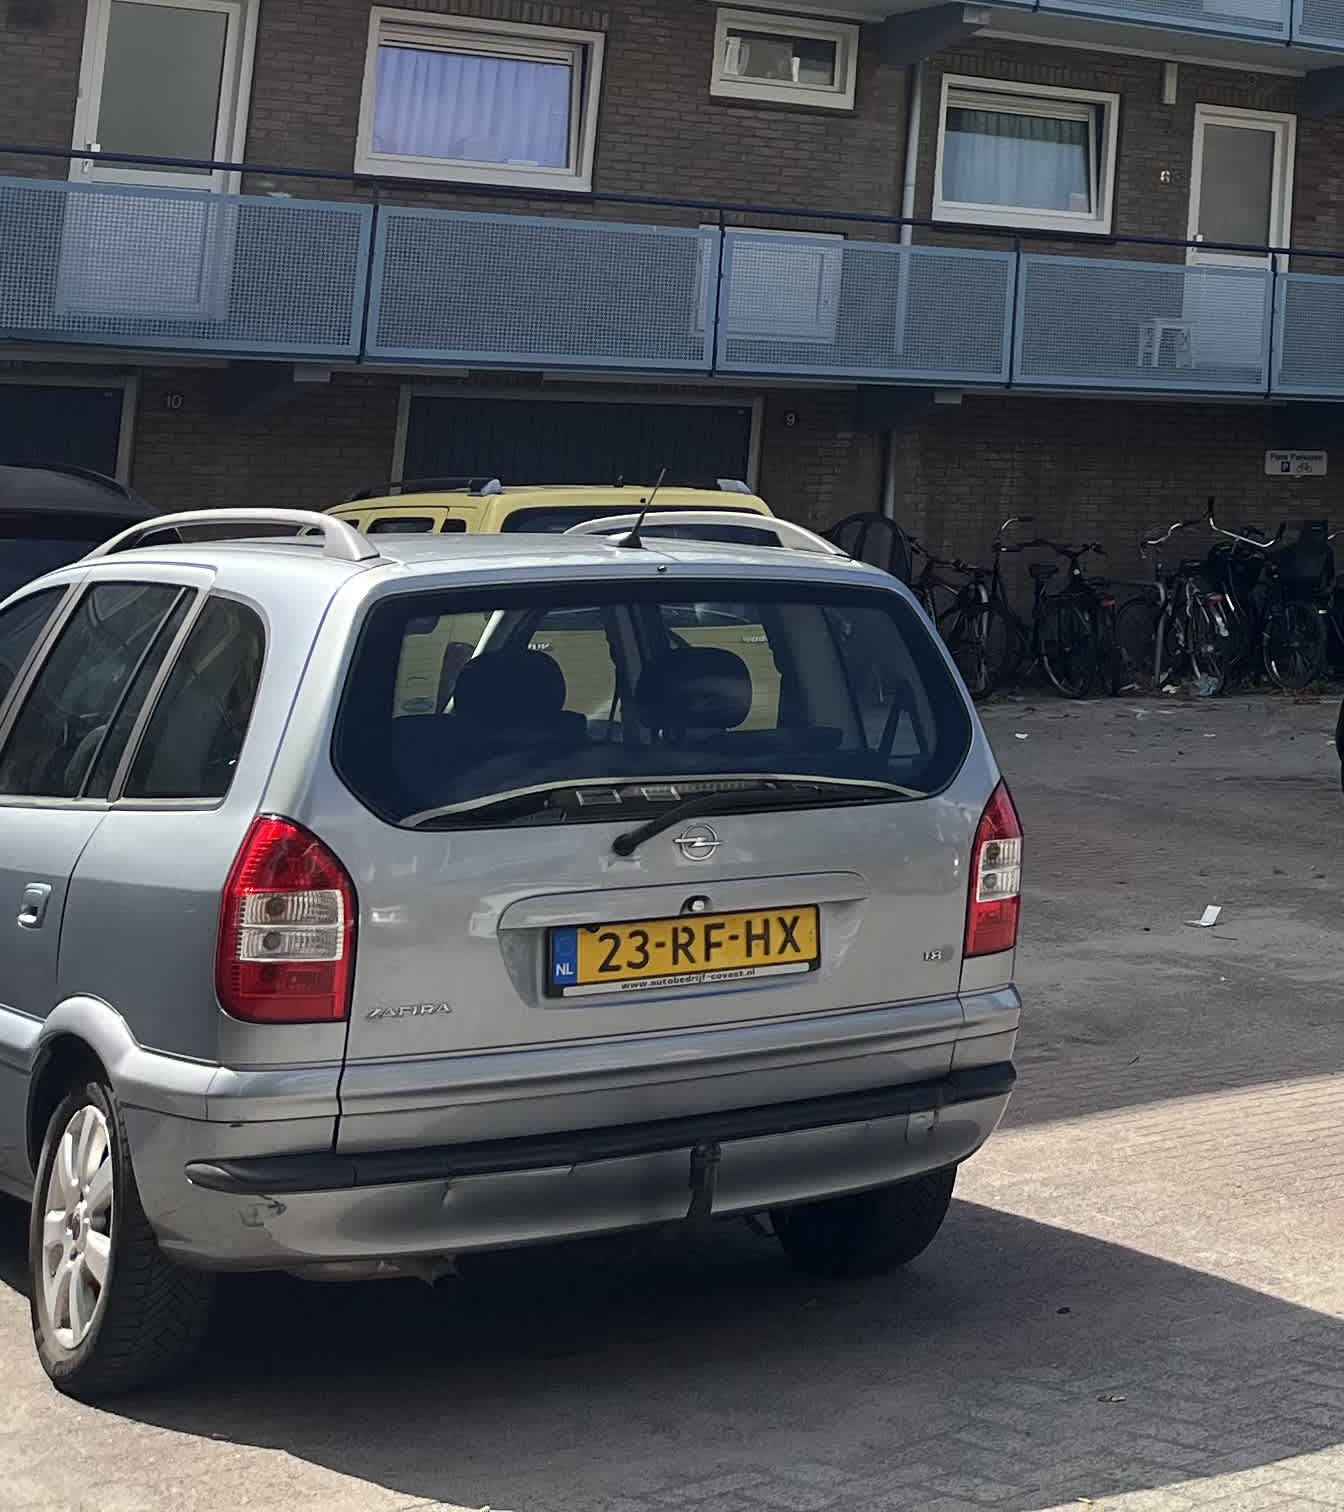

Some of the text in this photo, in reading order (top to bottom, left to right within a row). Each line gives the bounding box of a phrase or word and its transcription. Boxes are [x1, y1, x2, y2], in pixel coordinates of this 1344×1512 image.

[167, 393, 183, 409] 10
[598, 915, 802, 974] 23-RF-HX
[555, 963, 574, 977] NL
[366, 1002, 452, 1019] ZAFIRA
